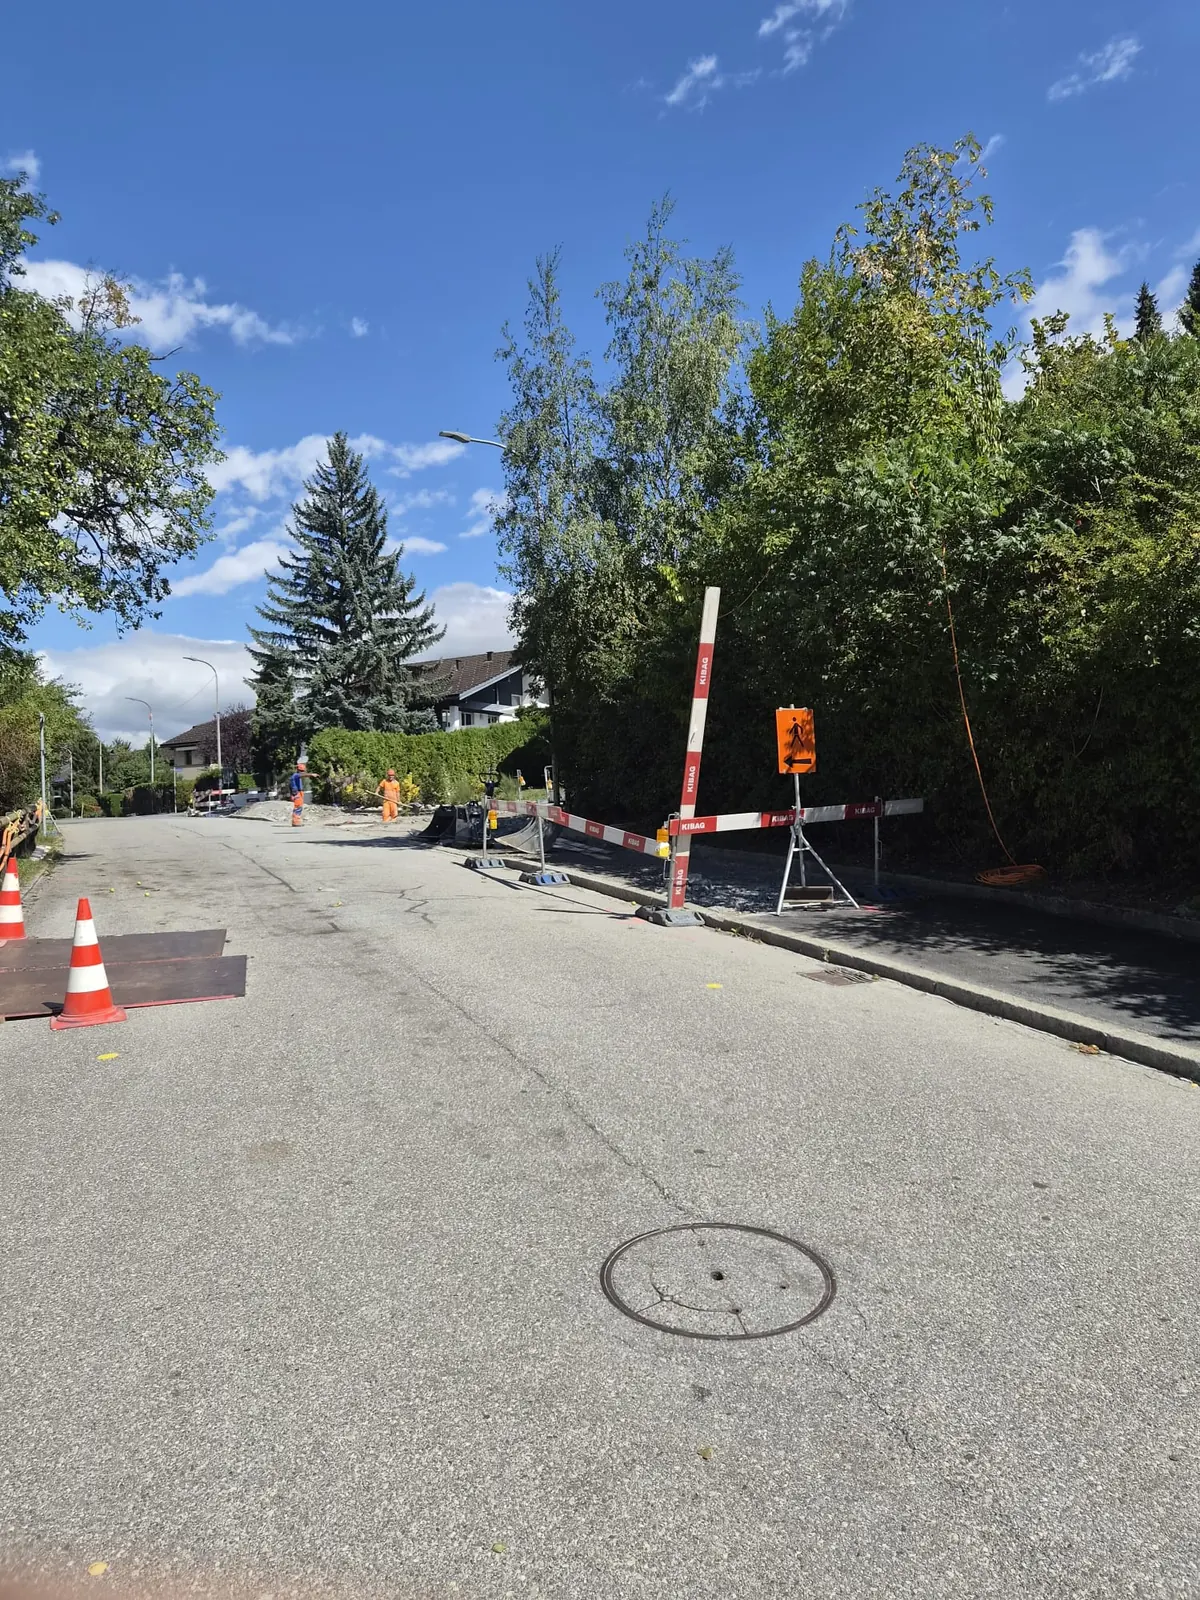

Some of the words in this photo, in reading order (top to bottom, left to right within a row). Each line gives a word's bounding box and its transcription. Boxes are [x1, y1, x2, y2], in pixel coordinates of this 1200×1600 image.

[699, 657, 709, 685] KIBAG
[686, 765, 696, 793] KIBAG
[771, 814, 794, 823] KIBAG
[854, 807, 876, 815] KIBAG
[681, 821, 706, 831] KIBAG
[674, 868, 684, 895] KIBAG
